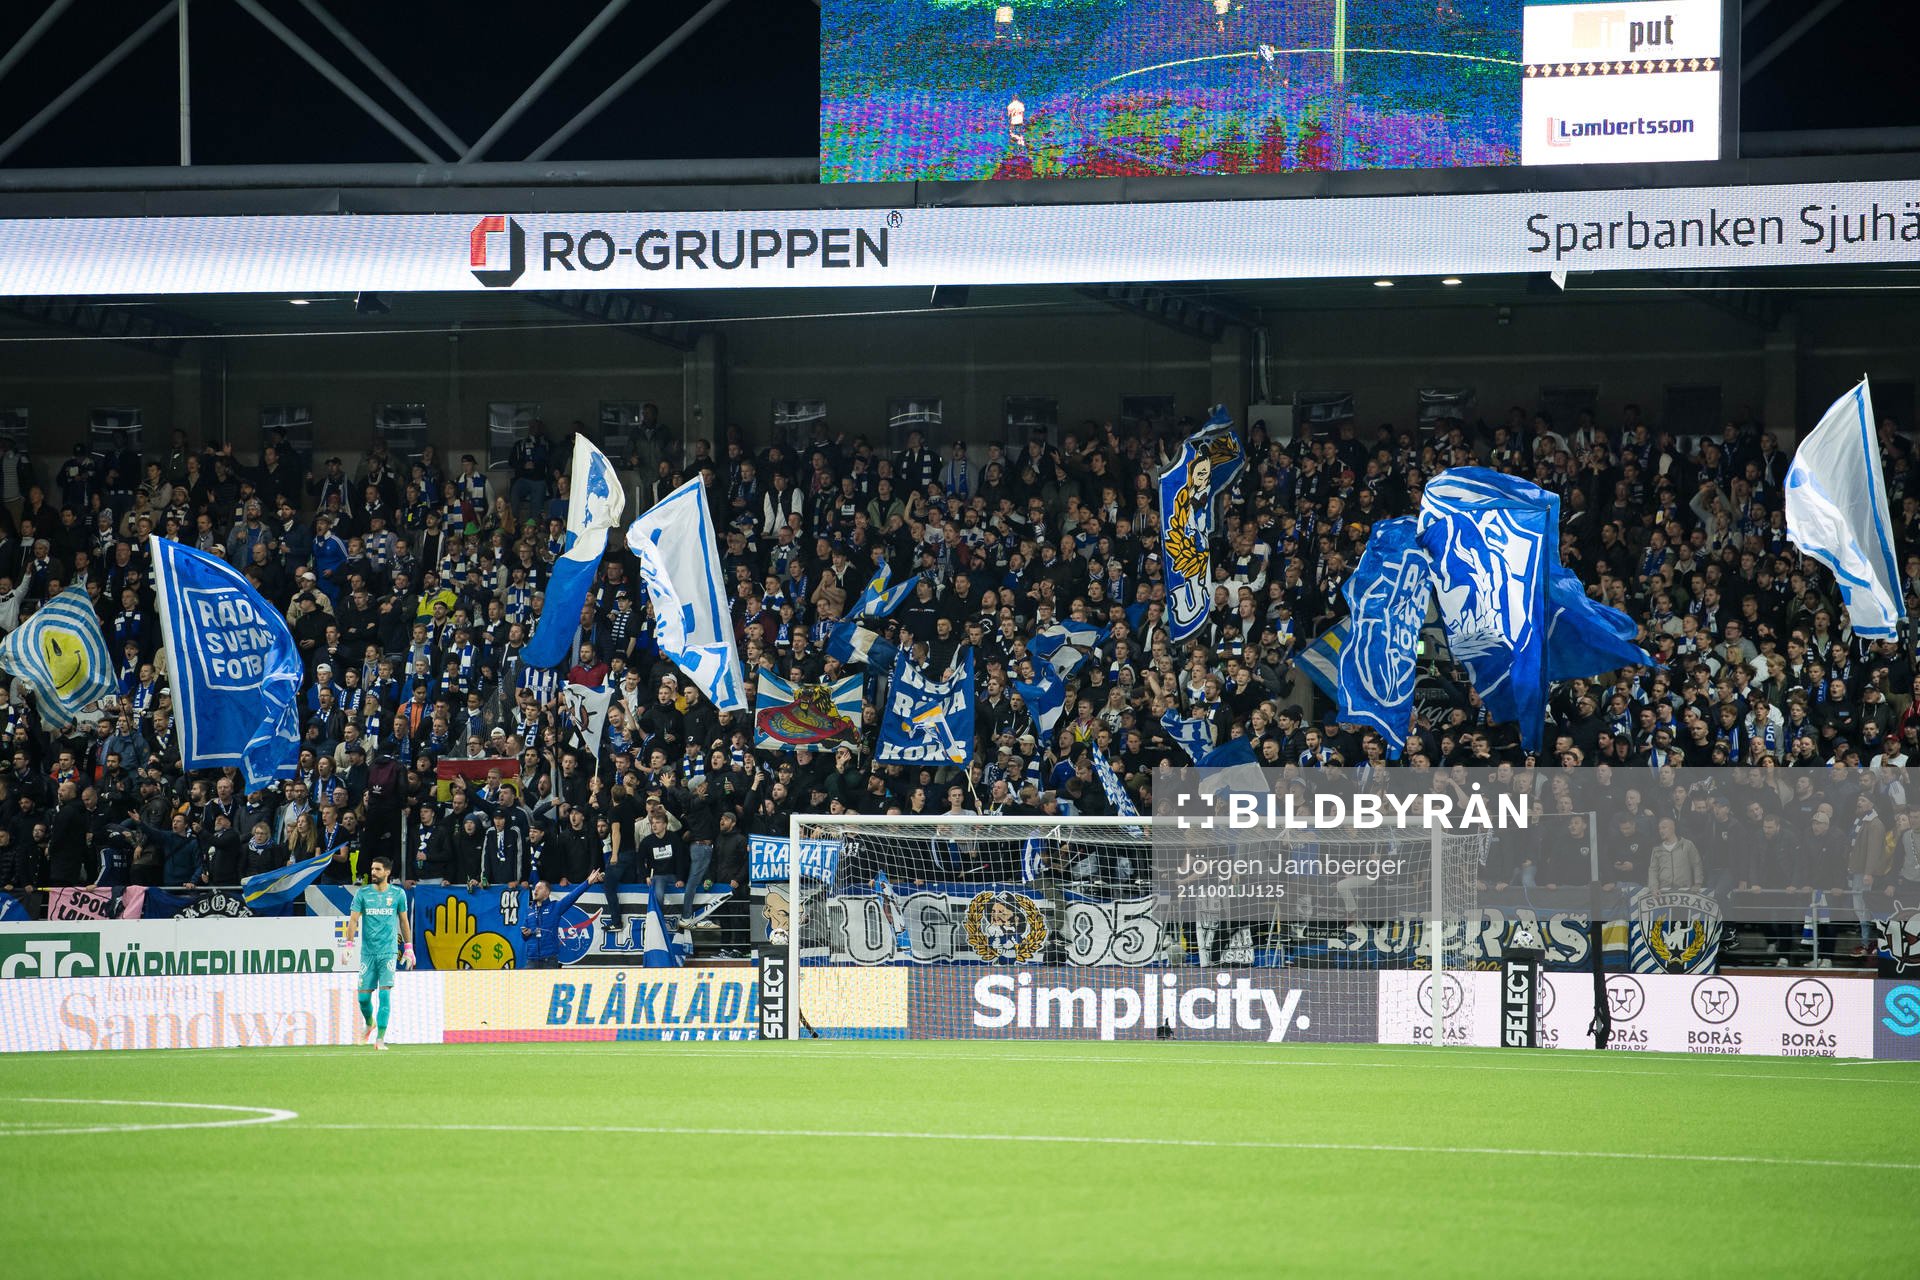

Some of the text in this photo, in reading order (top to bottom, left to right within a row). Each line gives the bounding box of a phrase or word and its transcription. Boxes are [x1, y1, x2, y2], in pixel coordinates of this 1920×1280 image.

[1630, 15, 1673, 52] put
[1560, 117, 1694, 137] Lambertsson
[1527, 208, 1784, 261] Sparbanken
[501, 891, 518, 908] OK
[1645, 894, 1714, 912] SUPRAS
[557, 927, 590, 940] ASA
[546, 971, 759, 1025] BLÅKLÄDE
[763, 957, 784, 1039] SELECT
[973, 971, 1310, 1042] Simplicity.
[1506, 961, 1530, 1047] SELECT
[661, 1030, 758, 1041] WORKWE
[1607, 1025, 1648, 1043] ORÅS
[1687, 1027, 1742, 1045] BORÅS
[1782, 1030, 1837, 1047] BORÅS
